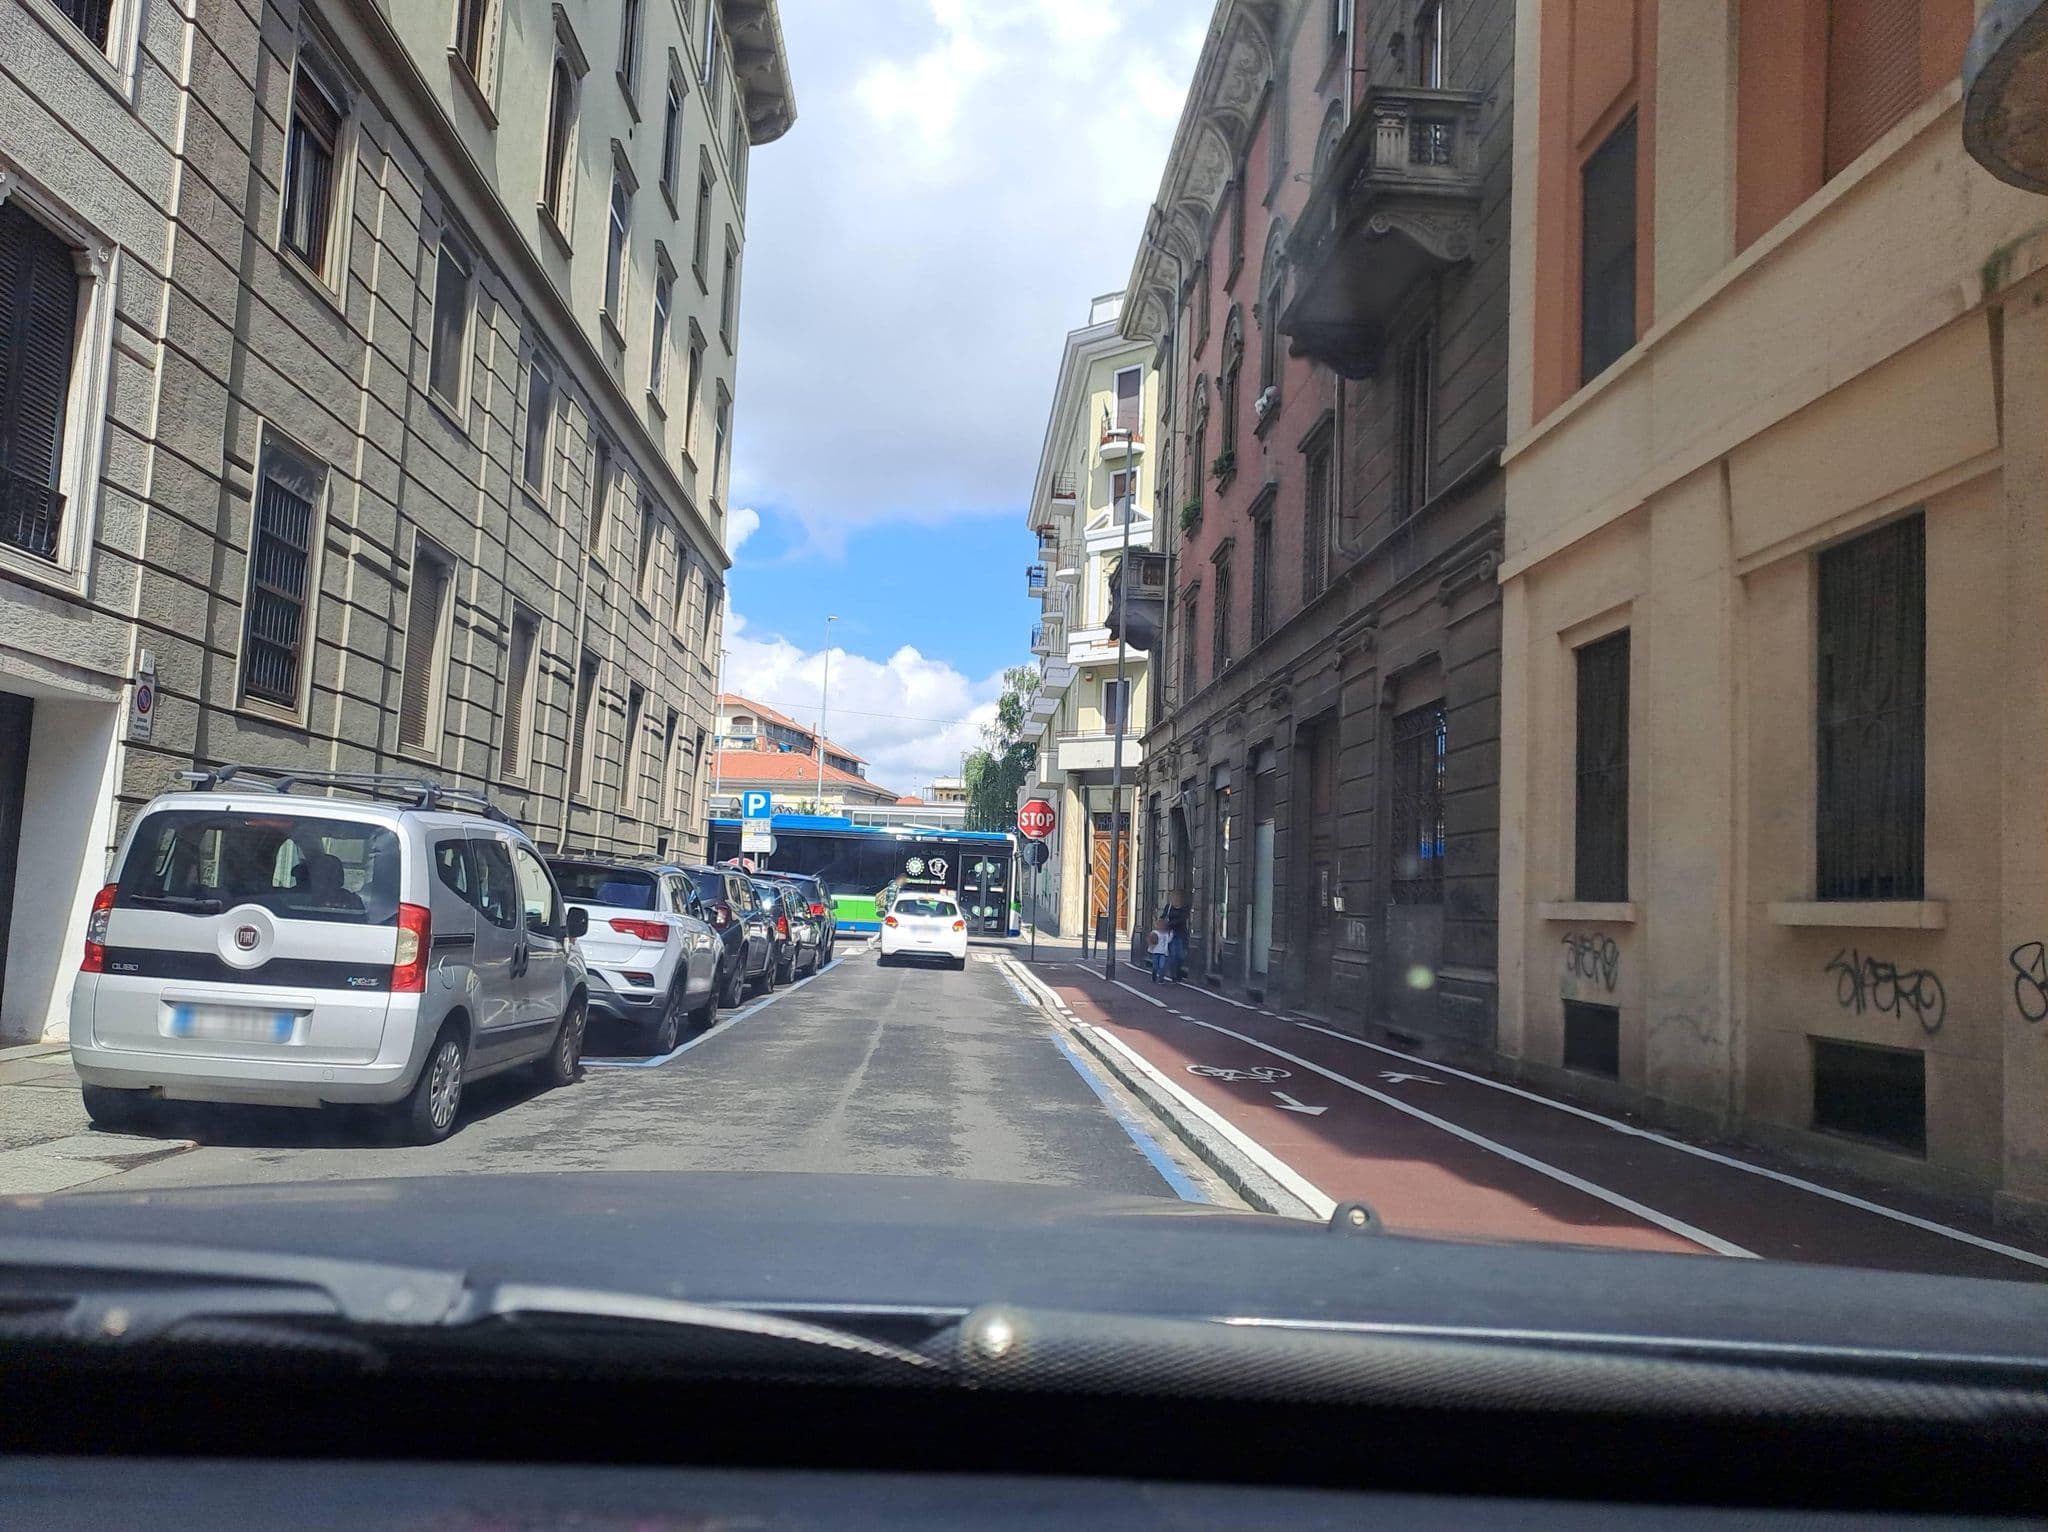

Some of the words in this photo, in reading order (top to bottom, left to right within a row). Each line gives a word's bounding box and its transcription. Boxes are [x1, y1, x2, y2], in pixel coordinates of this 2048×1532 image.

[748, 794, 766, 817] P
[1021, 812, 1054, 827] STOP
[240, 931, 255, 943] FIAT
[111, 962, 139, 972] QUBO
